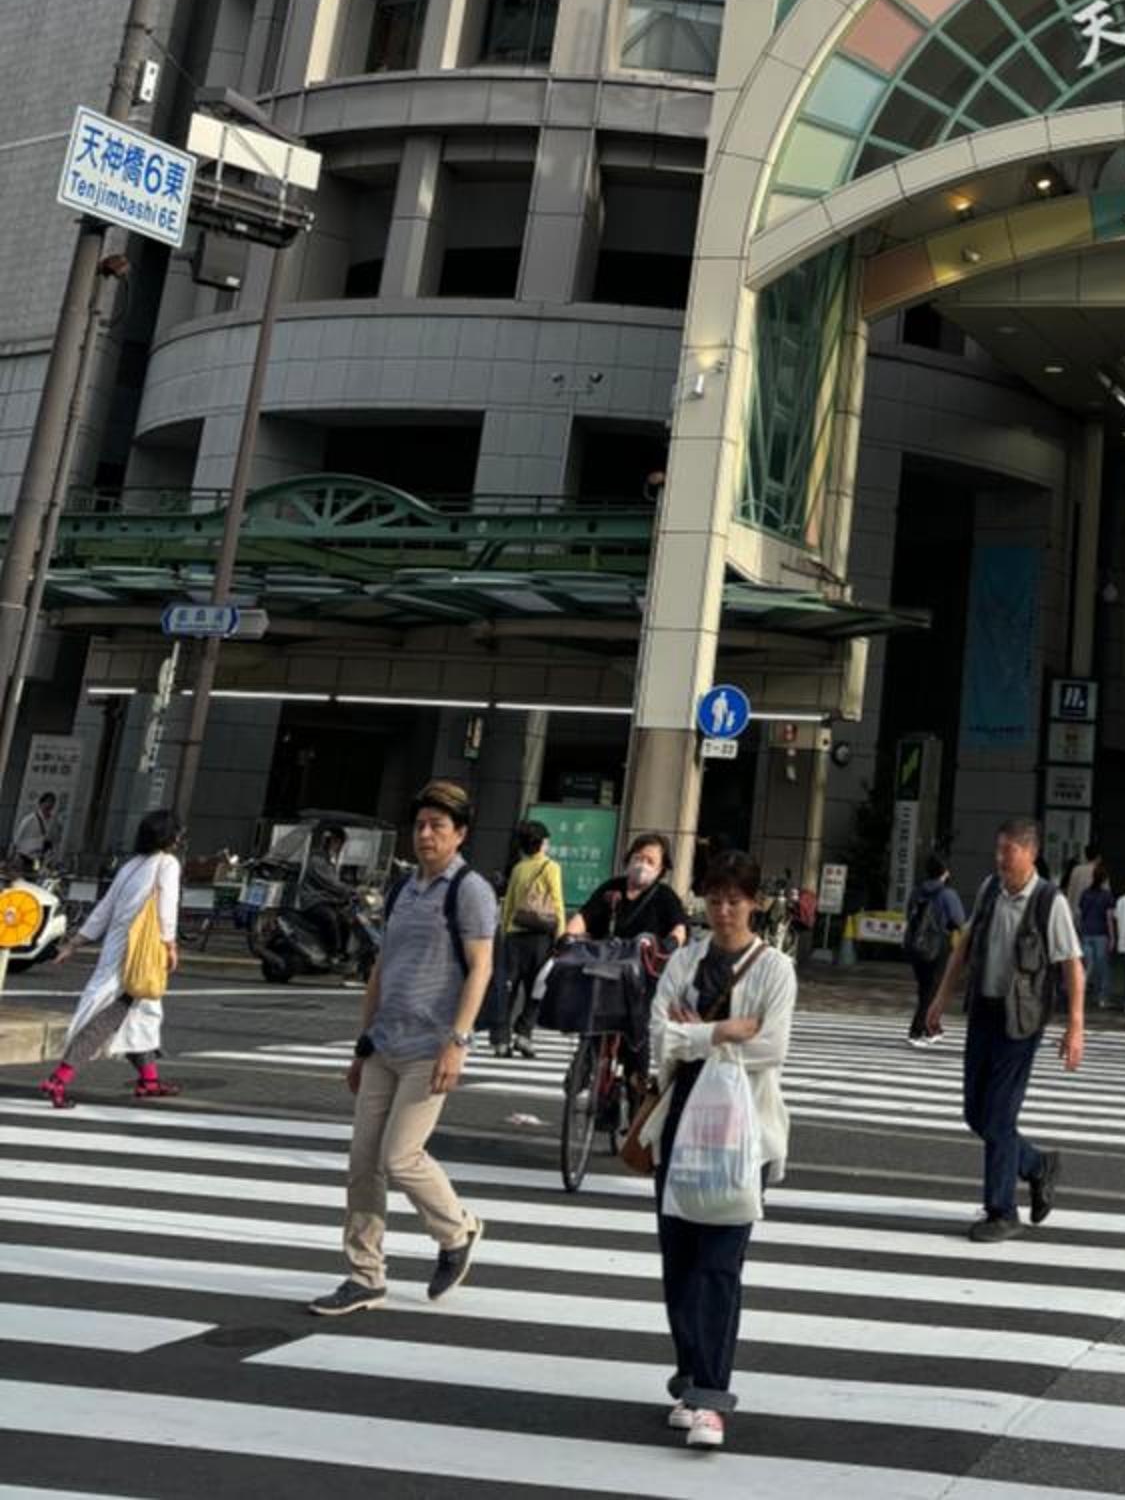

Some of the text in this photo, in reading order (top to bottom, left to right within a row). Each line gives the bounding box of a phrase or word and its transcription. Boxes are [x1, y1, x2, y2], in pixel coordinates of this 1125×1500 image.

[70, 170, 158, 223] Tenjimbashi
[76, 124, 186, 204] 天神橋6東
